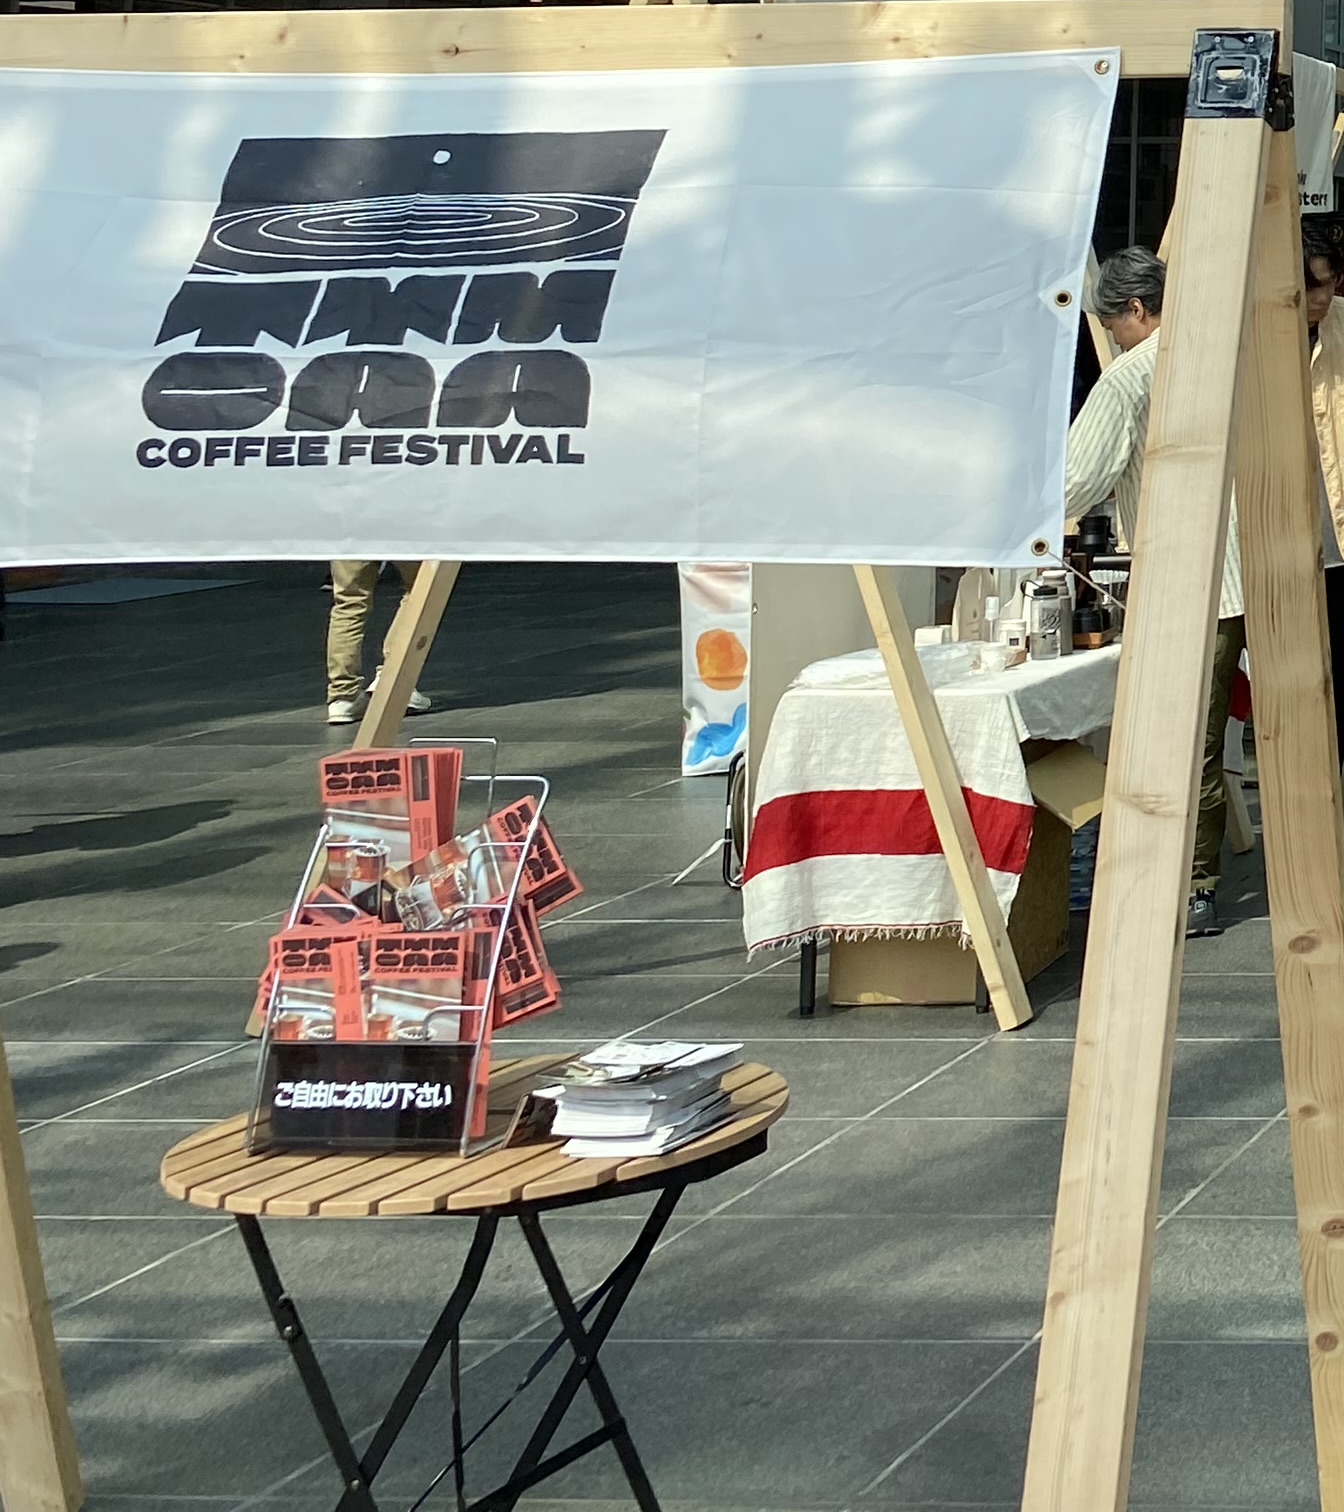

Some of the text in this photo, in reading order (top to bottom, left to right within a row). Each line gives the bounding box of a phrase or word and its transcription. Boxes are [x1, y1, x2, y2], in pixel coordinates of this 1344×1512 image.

[136, 433, 586, 469] COFFEE FESTIVAL
[274, 1080, 451, 1110] ご自由にお取り下さい
